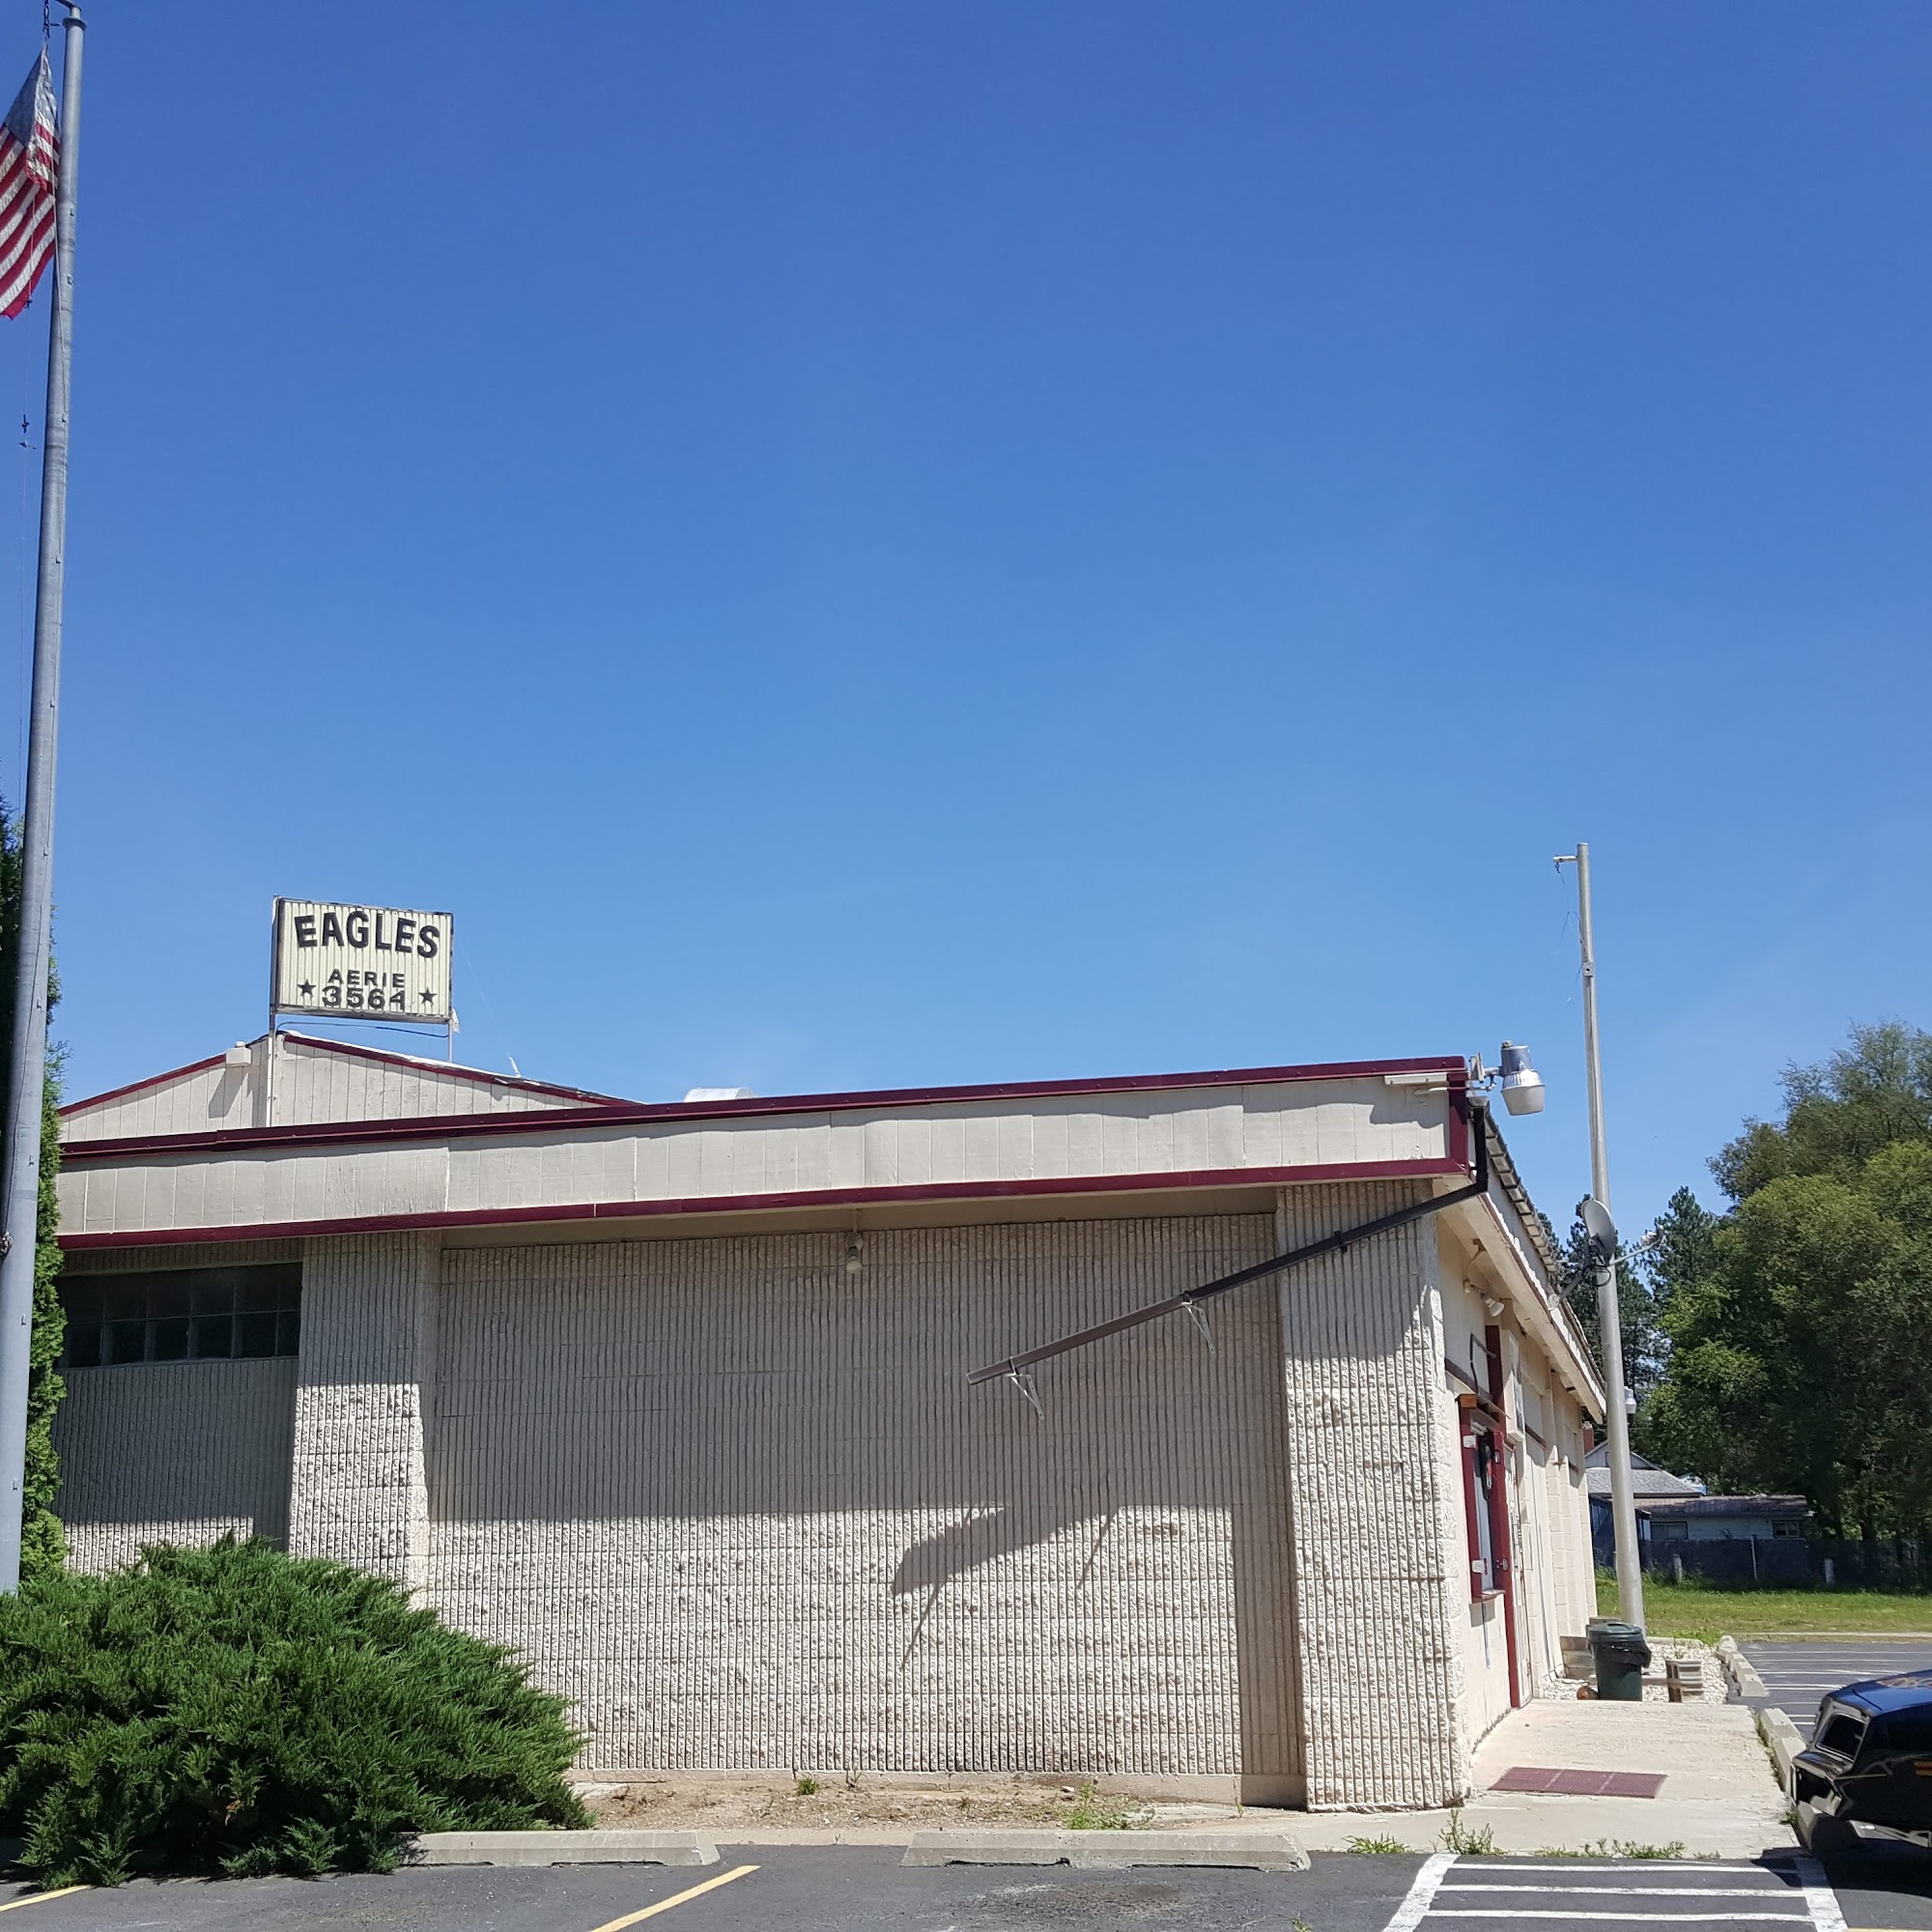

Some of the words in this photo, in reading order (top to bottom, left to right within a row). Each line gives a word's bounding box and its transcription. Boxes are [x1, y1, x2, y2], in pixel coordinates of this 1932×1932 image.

[295, 911, 440, 958] EAGLES
[327, 969, 405, 988] AERIE
[322, 985, 405, 1010] 3564
